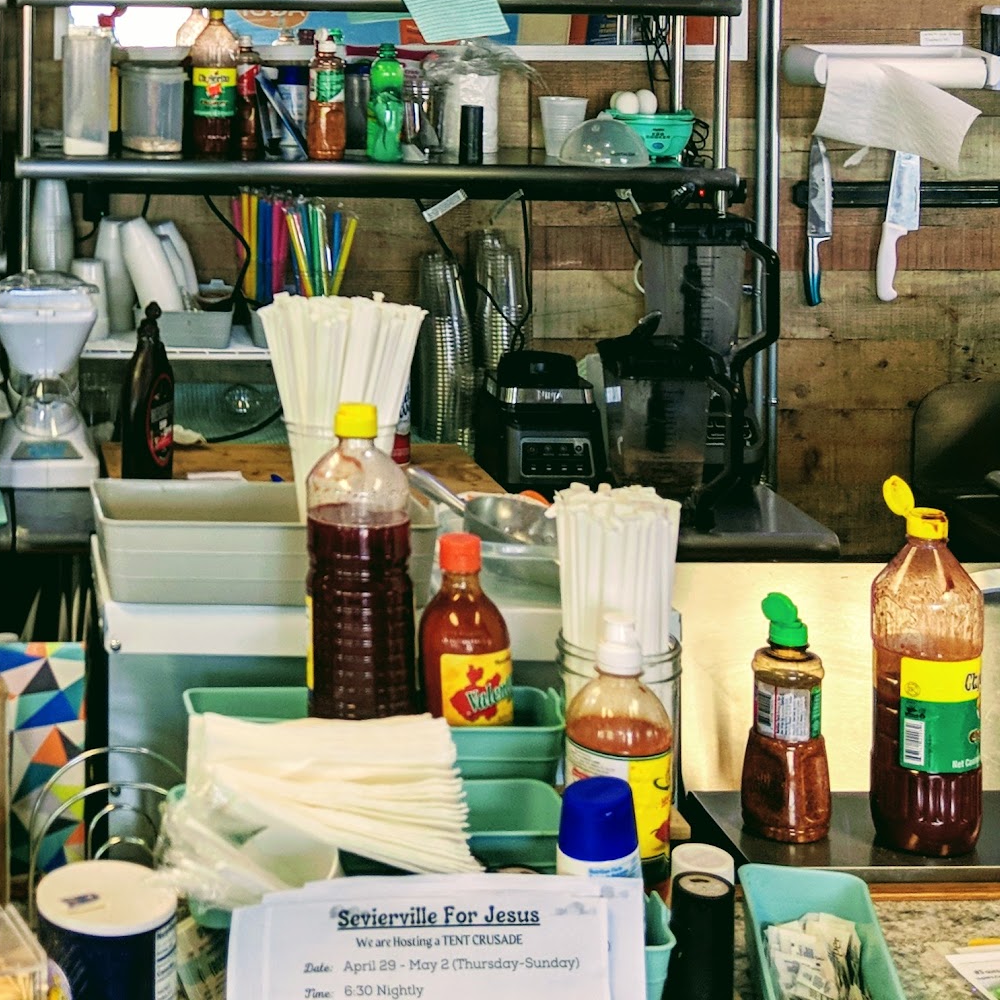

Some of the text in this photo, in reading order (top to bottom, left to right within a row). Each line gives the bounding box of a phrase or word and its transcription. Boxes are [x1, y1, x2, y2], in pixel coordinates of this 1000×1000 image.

[337, 904, 541, 927] Sevierville For Jesus
[356, 933, 524, 949] We are Hosting a TENT CRUSADE
[303, 961, 334, 974] Date:
[343, 960, 376, 975] April
[379, 959, 397, 971] 29
[409, 958, 438, 973] May
[441, 958, 450, 970] 2
[452, 956, 581, 972] (Thursday-Sunday)
[304, 983, 424, 1000] Time: 6:30 Nightly
